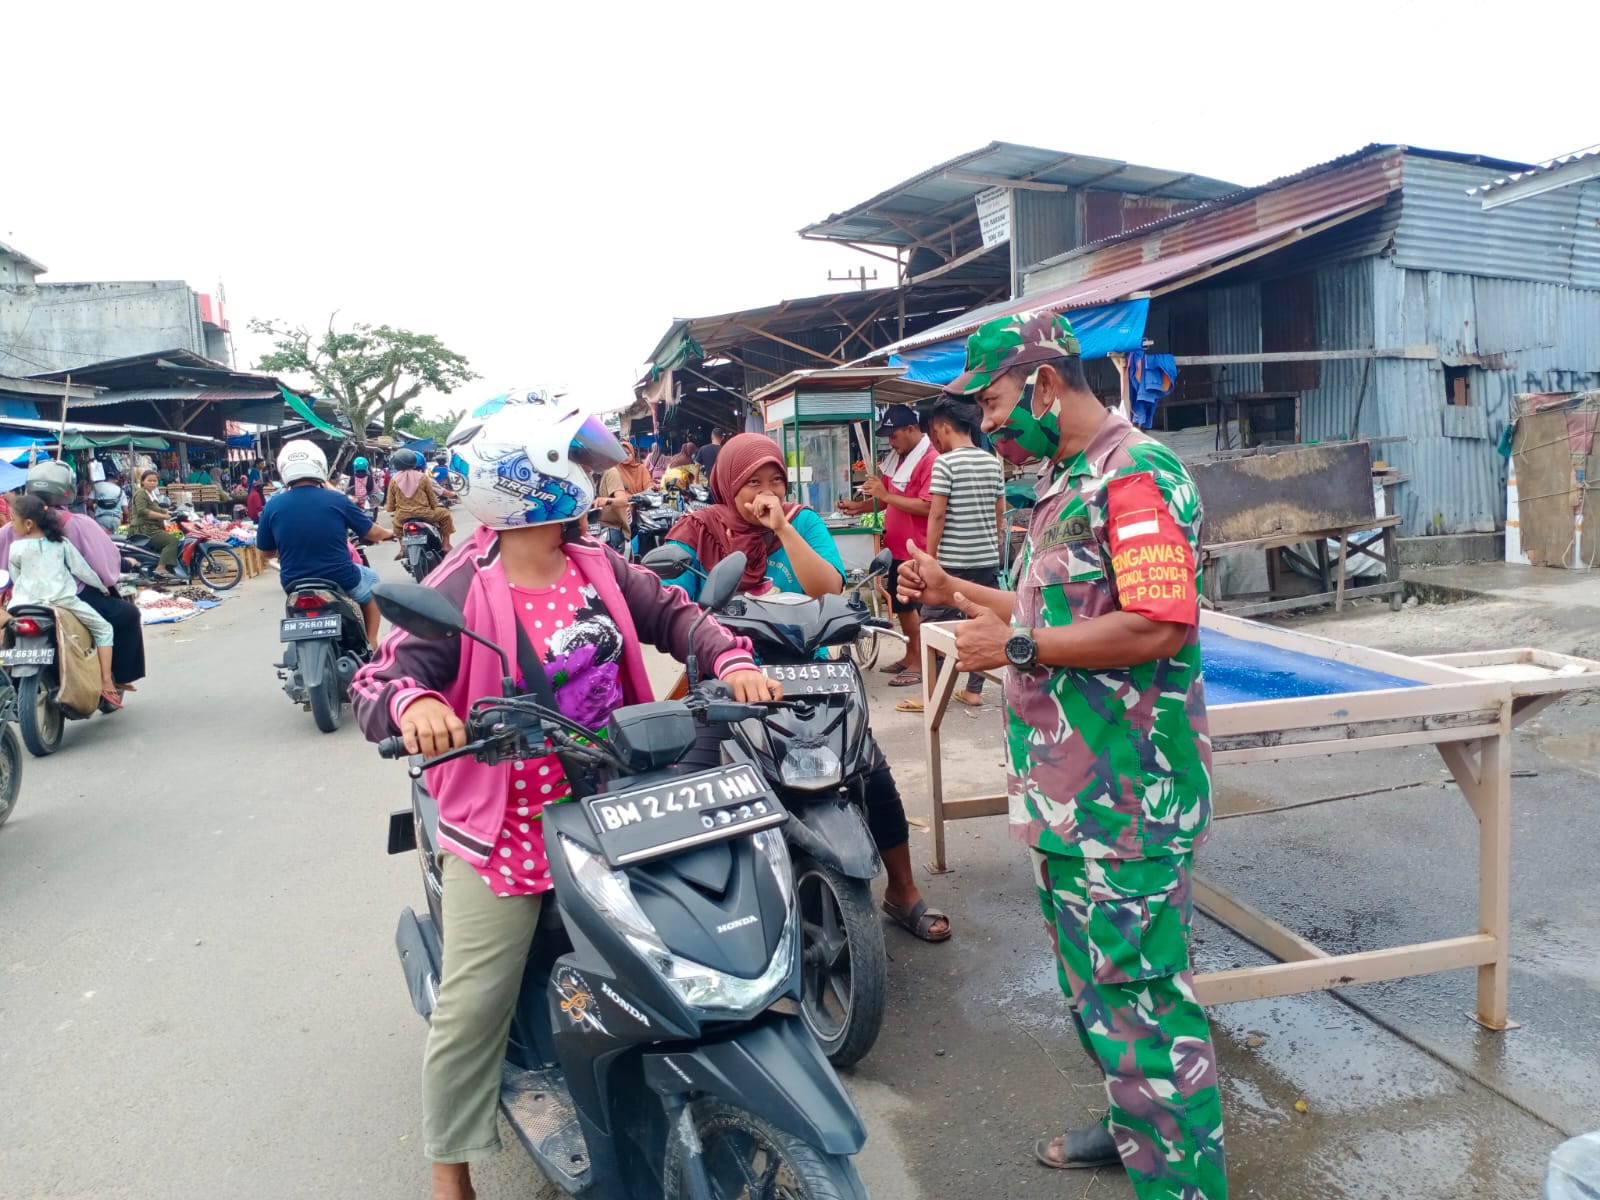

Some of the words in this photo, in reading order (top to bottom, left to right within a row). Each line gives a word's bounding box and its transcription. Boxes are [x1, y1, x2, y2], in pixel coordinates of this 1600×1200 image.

[499, 476, 557, 503] TREVIA
[1044, 521, 1085, 544] TNI-AD
[284, 622, 296, 631] BM
[775, 665, 820, 680] 5345
[826, 664, 850, 678] RX
[600, 801, 642, 830] BM
[642, 782, 716, 820] 2427
[718, 773, 758, 800] HN
[716, 915, 758, 933] HONDA
[601, 982, 650, 1027] HONDA
